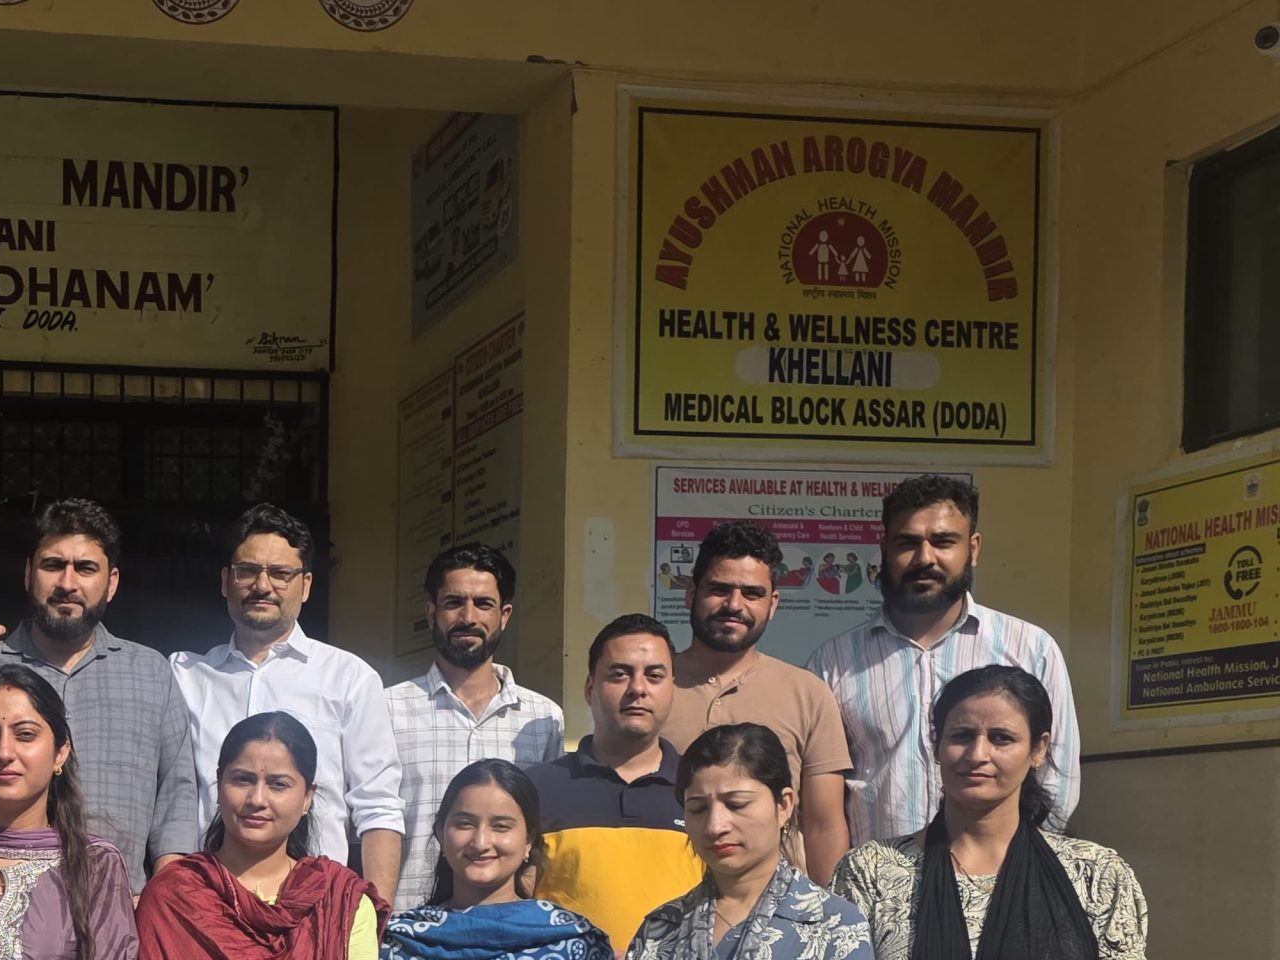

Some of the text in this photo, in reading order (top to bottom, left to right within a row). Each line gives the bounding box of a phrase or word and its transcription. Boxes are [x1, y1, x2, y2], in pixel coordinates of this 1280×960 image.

[655, 140, 797, 290] AYUSHMAN
[803, 135, 928, 194] AROGYA
[927, 170, 1018, 301] MANDIR
[778, 196, 902, 290] NATIONAL HEALTH MISSION
[659, 308, 1018, 350] HEALTH & WELLNESS CENTRE
[769, 347, 892, 387] KHELLANI
[664, 393, 1007, 437] MEDICAL BLOCK ASSAR (DODA)
[673, 477, 726, 495] SERVICES
[729, 479, 787, 497] AVAILABLE
[790, 480, 804, 496] AT
[806, 480, 847, 497] HEALTH
[850, 481, 859, 497] &
[748, 504, 883, 518] Citizen's Charter
[1145, 504, 1280, 551] NATIONAL HEALTH MIS
[1235, 567, 1262, 583] FREE
[1237, 558, 1254, 569] TOLL
[1209, 602, 1256, 623] JAMMU
[1143, 669, 1184, 683] National
[1187, 664, 1221, 678] Health
[1224, 659, 1269, 673] Mission,
[1142, 683, 1183, 698] National
[1186, 678, 1244, 695] Ambulance
